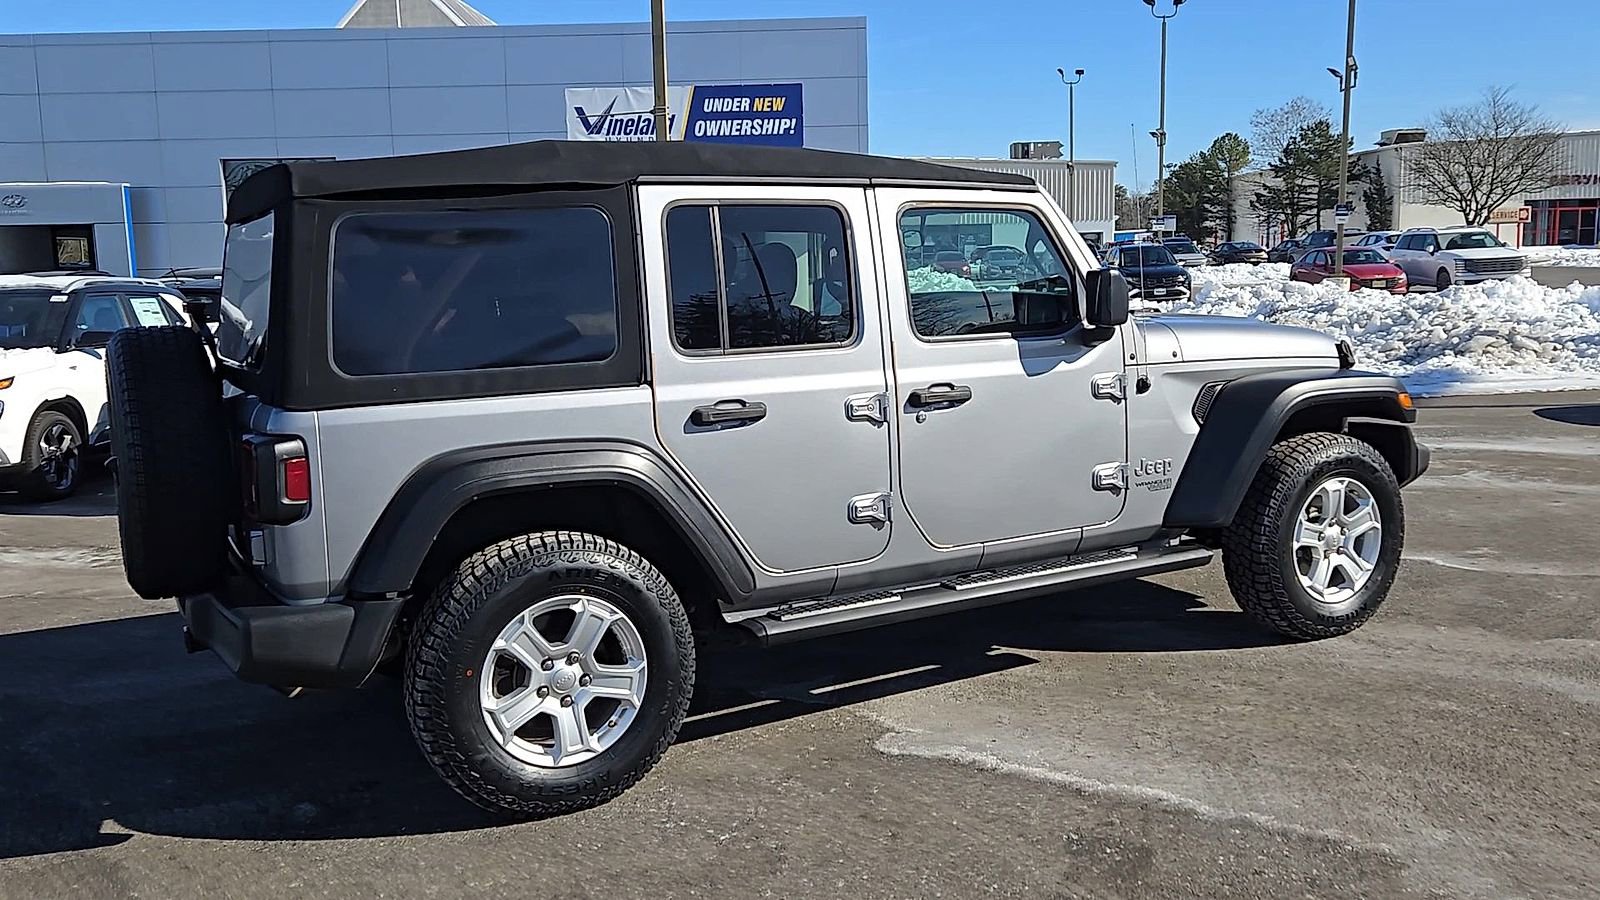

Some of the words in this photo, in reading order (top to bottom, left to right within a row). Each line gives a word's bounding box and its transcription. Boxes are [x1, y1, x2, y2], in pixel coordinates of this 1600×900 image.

[703, 98, 749, 113] UNDER
[752, 97, 786, 112] NEW
[574, 96, 676, 136] Vinelad
[694, 118, 796, 137] OWNERSHIP!
[1492, 210, 1519, 219] SERVICE
[1134, 458, 1172, 477] Jeep
